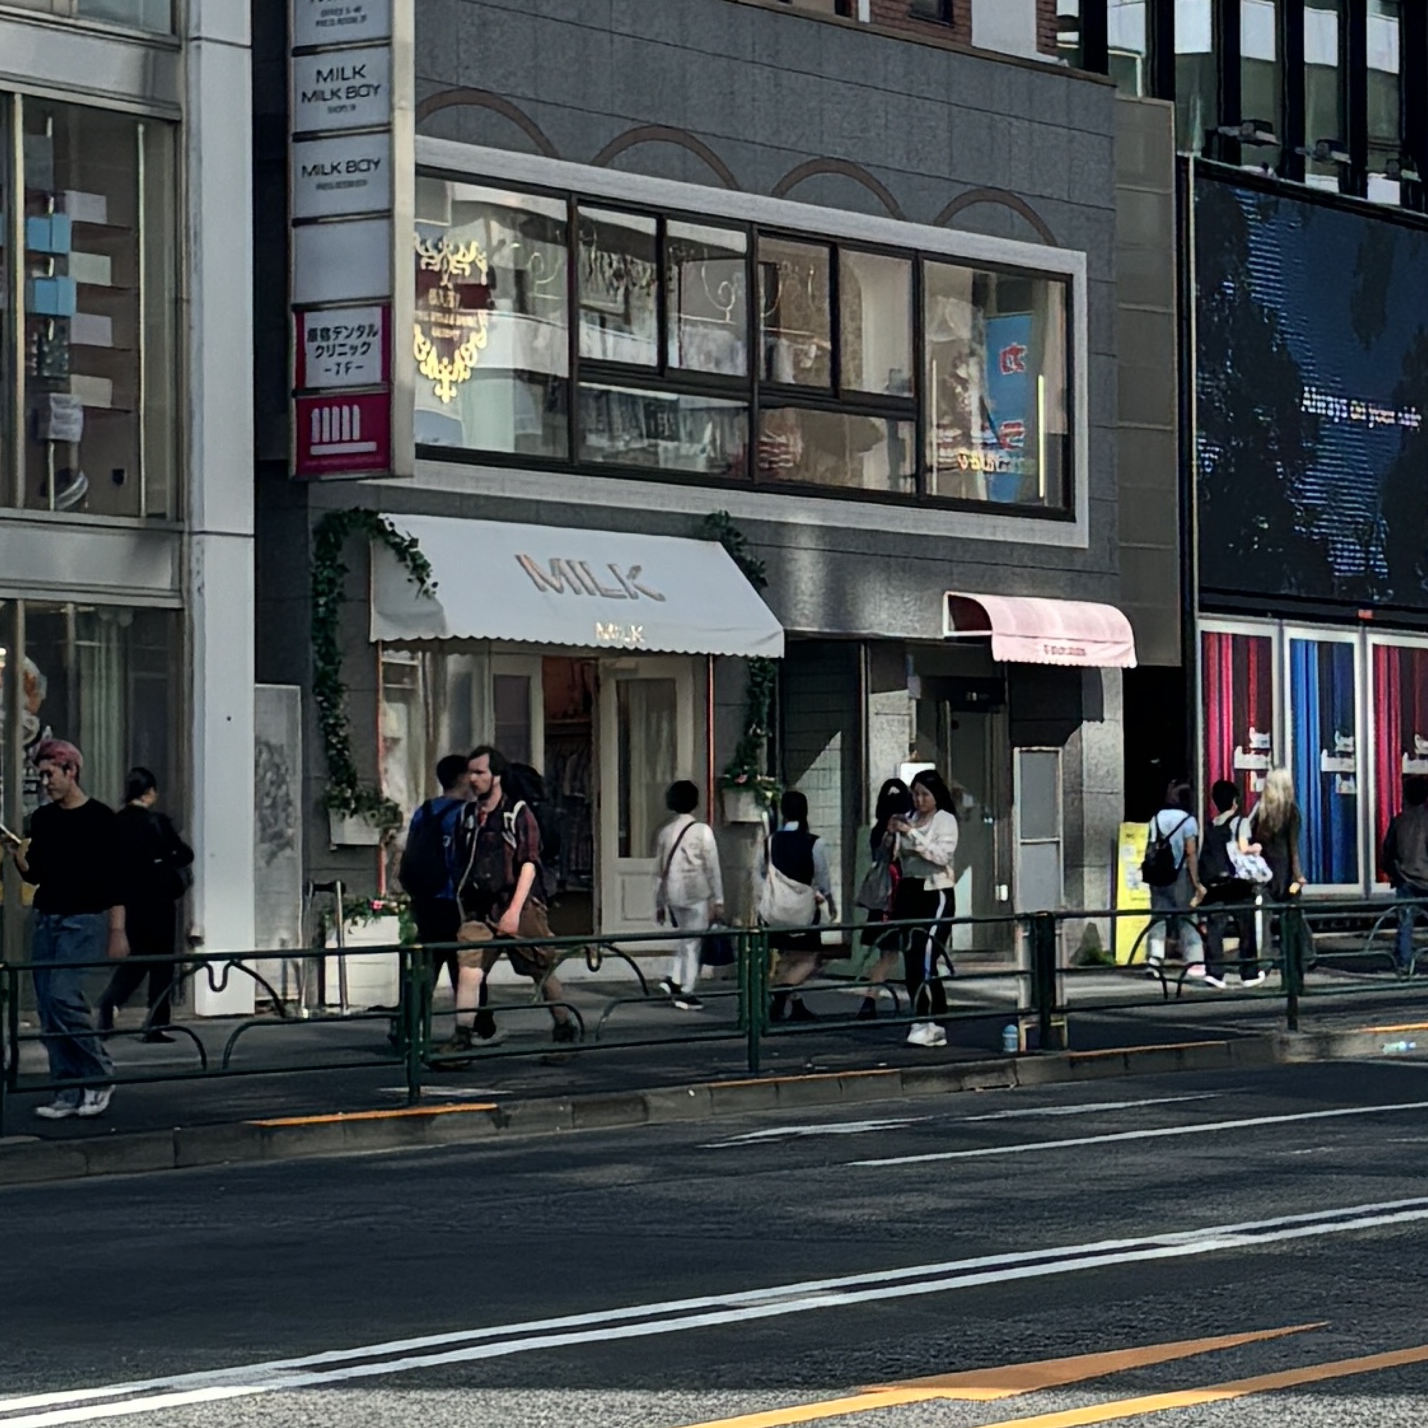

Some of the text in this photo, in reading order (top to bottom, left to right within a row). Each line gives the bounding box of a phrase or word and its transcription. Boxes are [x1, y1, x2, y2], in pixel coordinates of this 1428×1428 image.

[315, 64, 367, 84] MILK
[301, 83, 381, 104] MILK BOY
[301, 158, 381, 179] MILK BOY
[315, 341, 372, 359] クリニック
[514, 553, 667, 602] MILK
